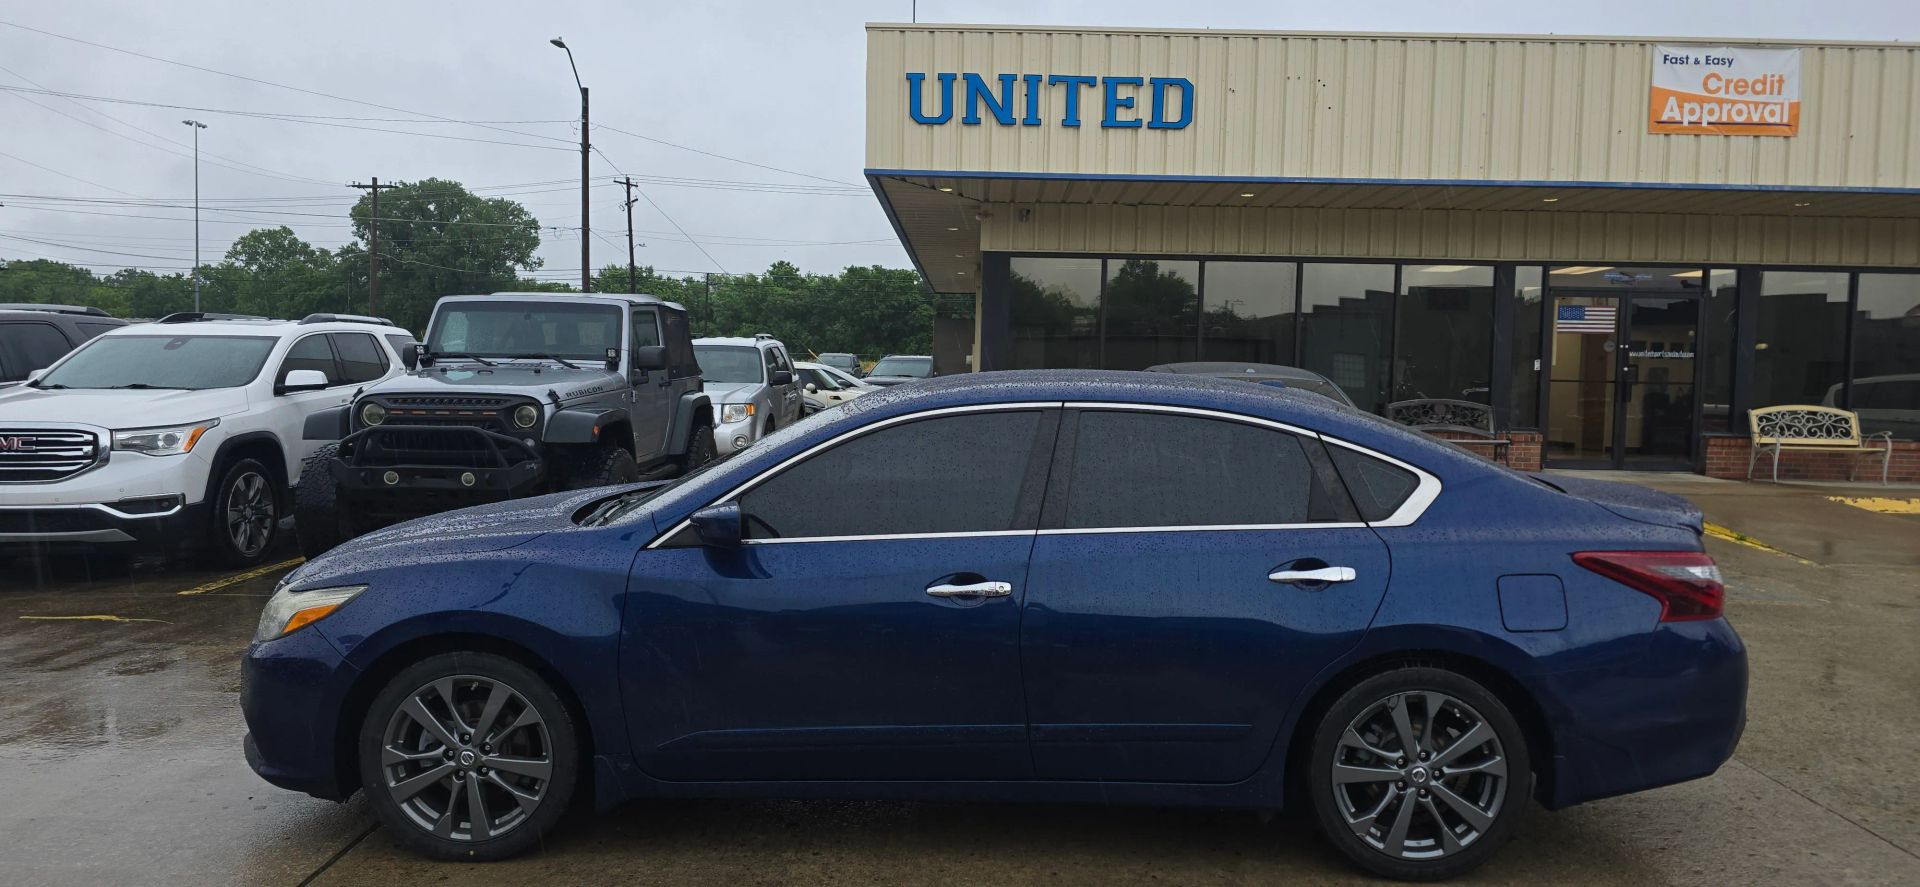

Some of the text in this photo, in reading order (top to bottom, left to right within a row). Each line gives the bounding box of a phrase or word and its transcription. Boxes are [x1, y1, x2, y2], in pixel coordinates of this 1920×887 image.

[1663, 54, 1734, 68] Fast & Easy
[1702, 72, 1785, 96] Credit
[906, 72, 1194, 129] UNITED
[1660, 96, 1790, 127] Approval
[565, 386, 604, 398] RUBICON
